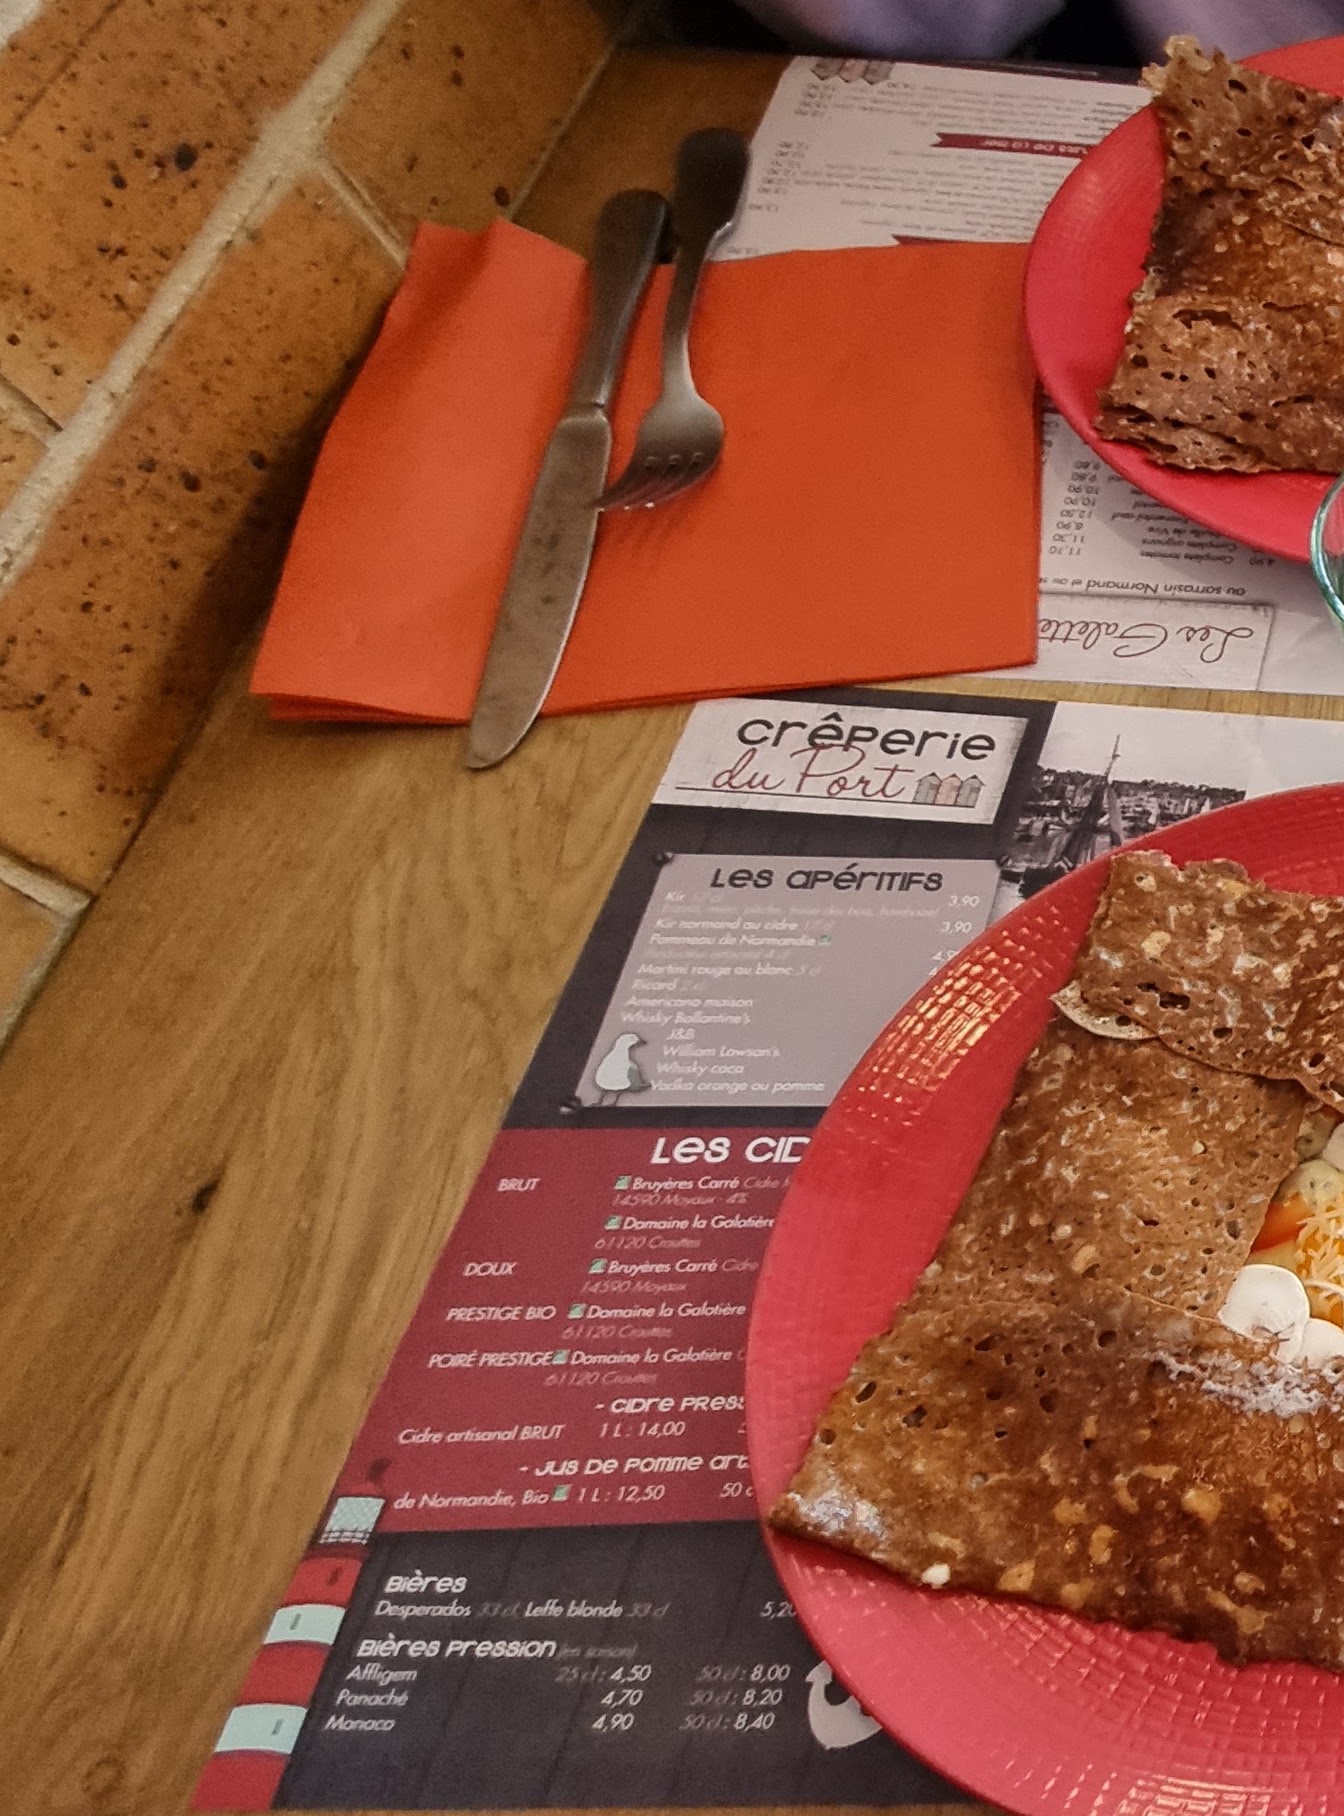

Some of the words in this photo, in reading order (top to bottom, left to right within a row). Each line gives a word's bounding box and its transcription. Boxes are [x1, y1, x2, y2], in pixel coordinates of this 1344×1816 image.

[1085, 578, 1157, 594] Normand
[1039, 618, 1168, 658] Galette
[1176, 626, 1253, 664] Les
[712, 749, 784, 792] du
[790, 744, 915, 798] Port
[941, 922, 972, 933] 3,90
[746, 1136, 811, 1163] CID
[498, 1178, 540, 1192] BRUT
[632, 1176, 692, 1191] Bruyères
[698, 1175, 740, 1189] Carré
[623, 1216, 688, 1229] Domaine
[692, 1215, 707, 1228] la
[463, 1262, 517, 1276] DOUX
[608, 1261, 671, 1275] Bruyères
[675, 1259, 718, 1273] Carré
[446, 1307, 525, 1321] PRESTIGE
[527, 1306, 556, 1320] BIO
[587, 1305, 654, 1319] Domaine
[658, 1303, 674, 1317] la
[570, 1351, 640, 1365] Domaine
[643, 1349, 658, 1363] la
[398, 1428, 443, 1443] Cidre
[447, 1425, 518, 1442] artisanal
[520, 1424, 565, 1439] BRUT
[639, 1421, 686, 1438] 14,00
[393, 1494, 419, 1509] de
[617, 1485, 665, 1502] 12,50
[374, 1601, 472, 1621] Desperados
[524, 1602, 565, 1618] Leffe
[567, 1602, 622, 1618] blonde
[345, 1665, 417, 1683] Affligem
[609, 1665, 652, 1683] 4,50
[749, 1665, 790, 1683] 8,00
[335, 1688, 408, 1708] Panaché
[600, 1690, 643, 1707] 4,70
[742, 1689, 783, 1707] 8,20
[324, 1714, 395, 1731] Monaco
[592, 1714, 634, 1731] 4,90
[734, 1713, 775, 1731] 8,40
